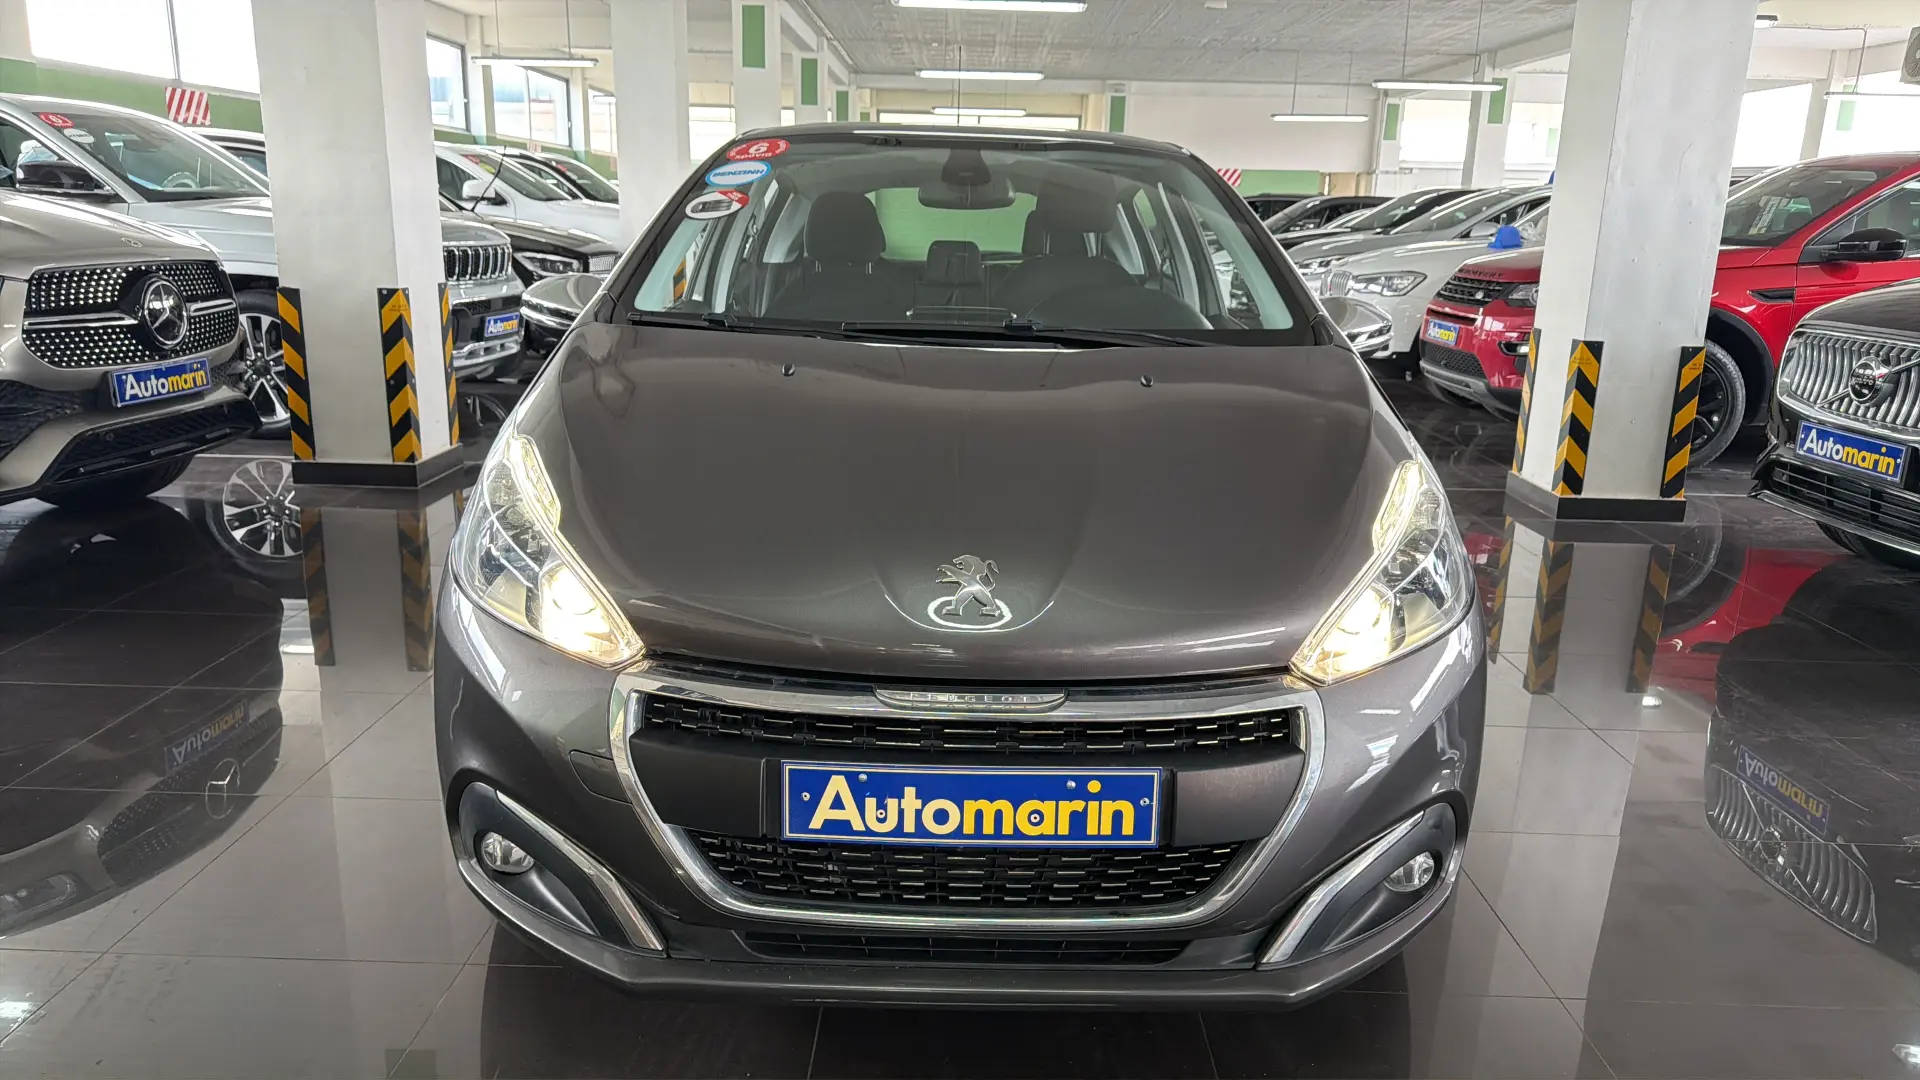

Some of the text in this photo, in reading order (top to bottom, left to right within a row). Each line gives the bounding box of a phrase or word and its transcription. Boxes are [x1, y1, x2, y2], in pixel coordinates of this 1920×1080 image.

[748, 143, 769, 154] 6
[125, 363, 206, 400] Automarin
[1803, 428, 1895, 475] Automarin
[909, 692, 1028, 703] PEUGEOT
[808, 775, 1134, 836] Automarin
